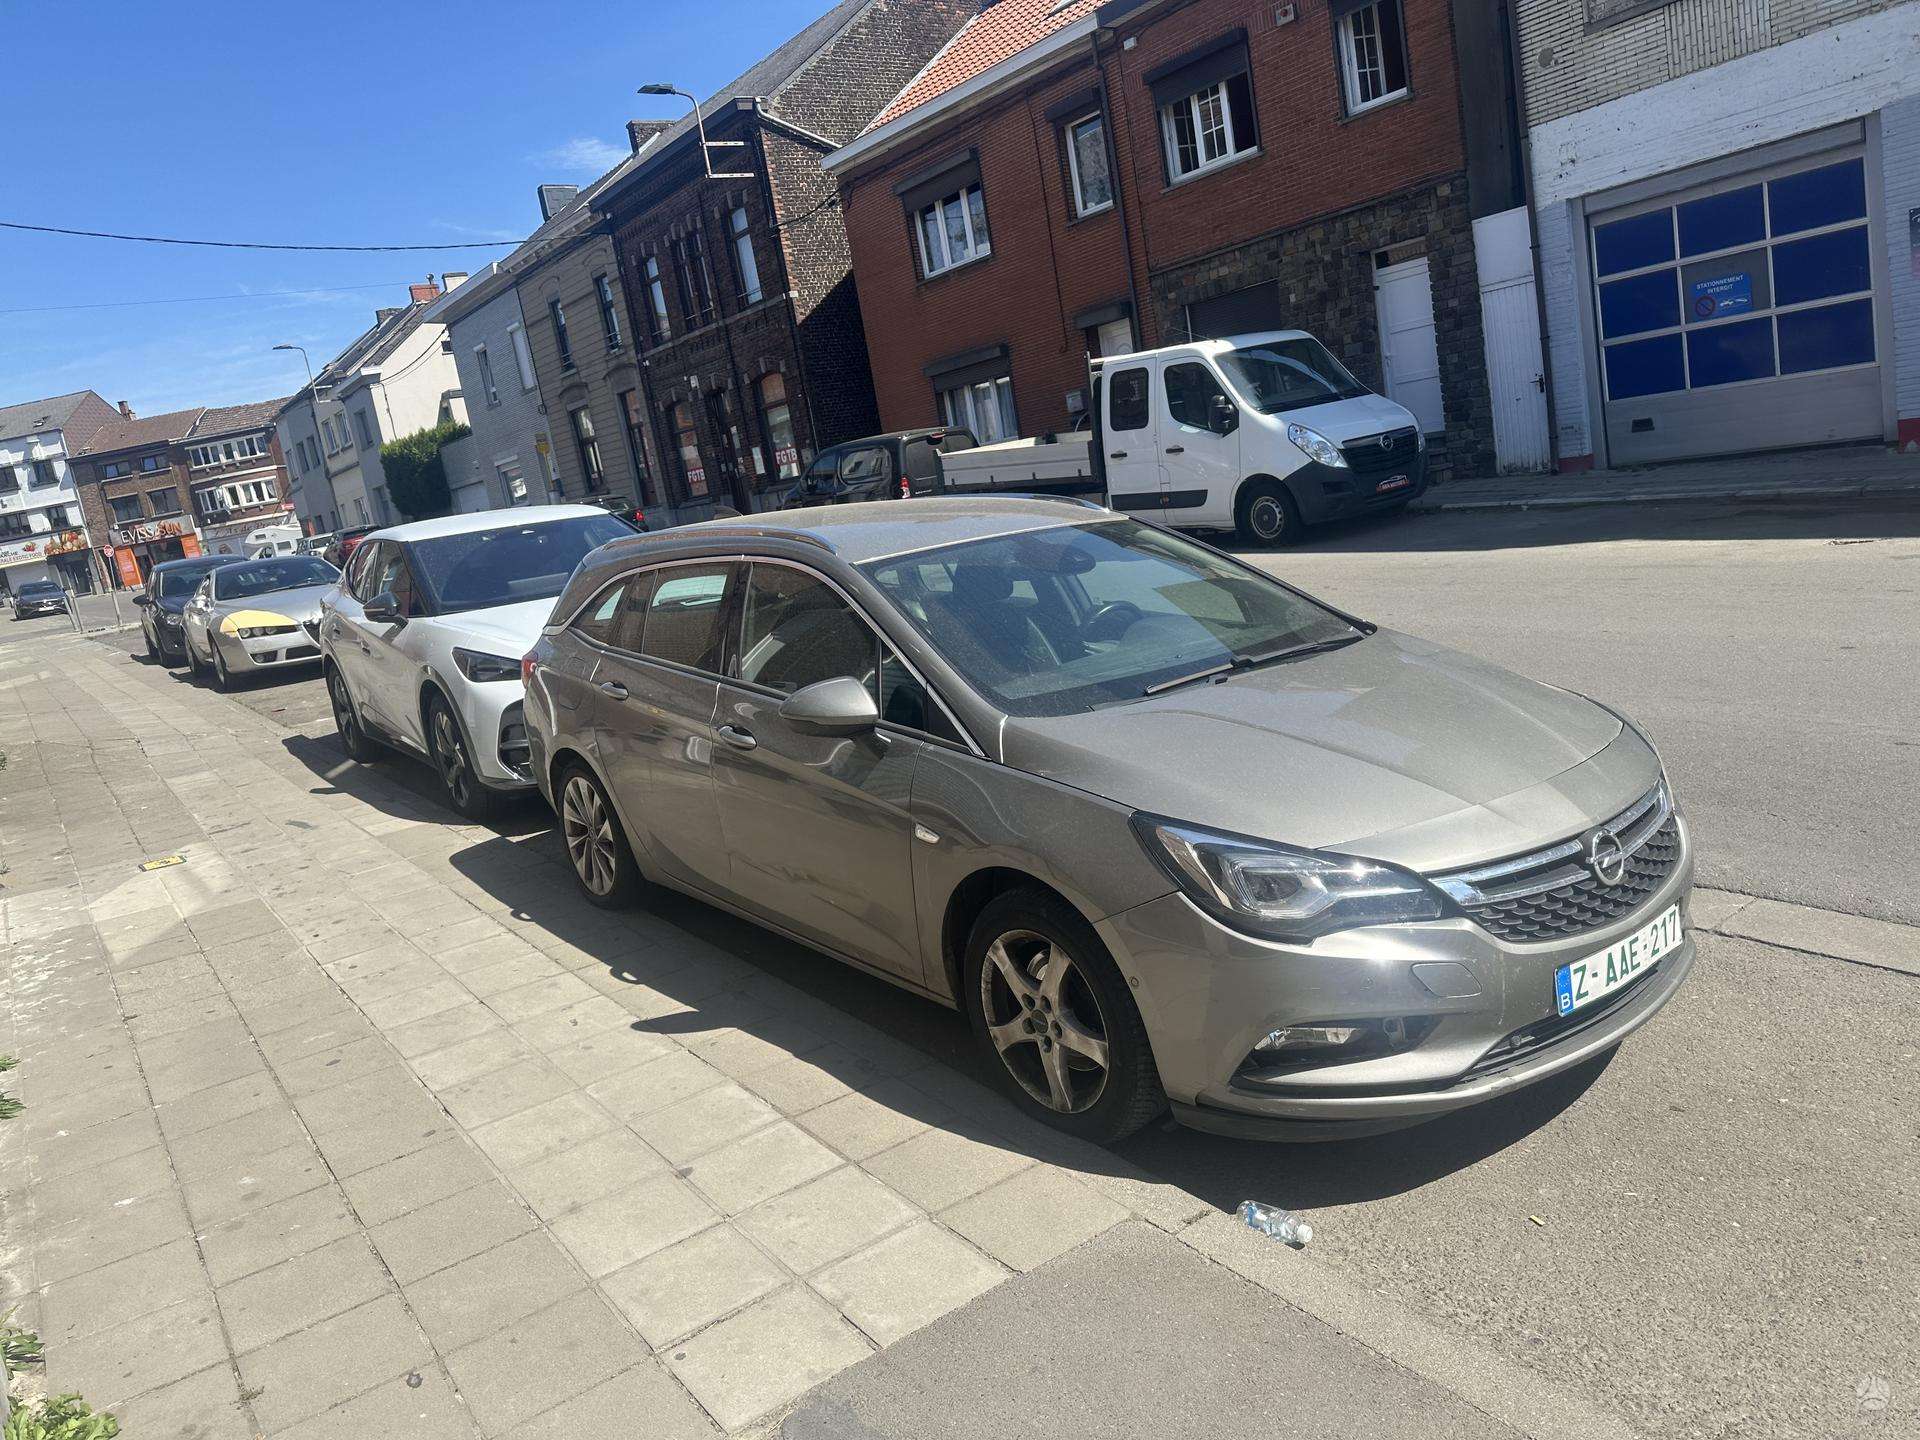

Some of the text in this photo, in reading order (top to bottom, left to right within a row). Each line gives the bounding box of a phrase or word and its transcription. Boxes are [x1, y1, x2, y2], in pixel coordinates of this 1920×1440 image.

[1696, 274, 1744, 290] STATIONNEMENT
[1707, 283, 1734, 294] INTERDIT
[775, 448, 798, 465] FGTB
[687, 469, 706, 483] FGTB
[1561, 993, 1571, 1009] B
